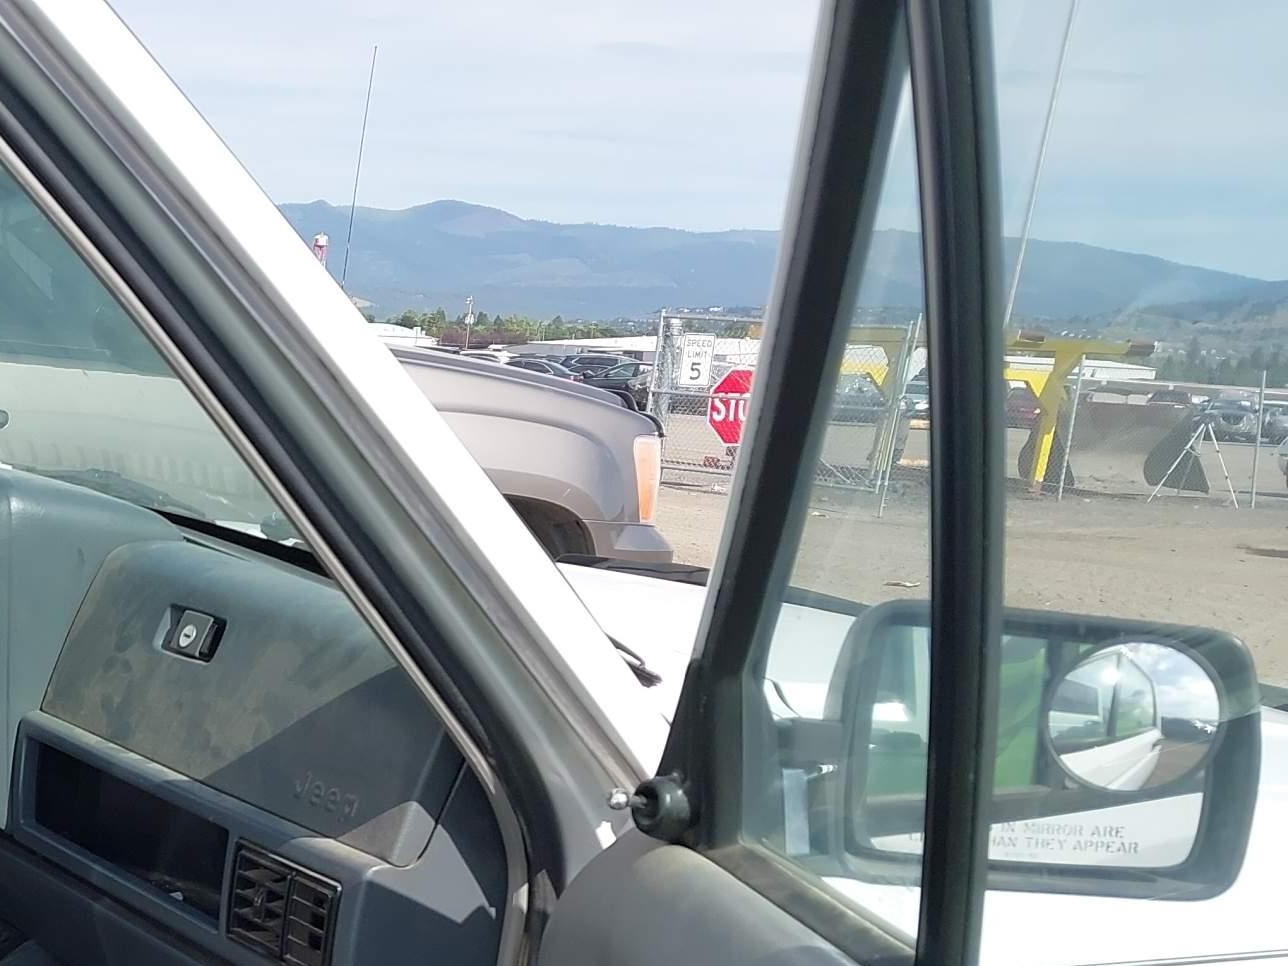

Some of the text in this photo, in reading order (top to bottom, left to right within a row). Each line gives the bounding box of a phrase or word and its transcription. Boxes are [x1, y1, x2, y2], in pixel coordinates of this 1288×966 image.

[686, 339, 712, 348] SPEED
[687, 351, 708, 359] LIMIT
[690, 362, 702, 380] 5
[711, 392, 749, 422] STO
[294, 770, 360, 823] Jeep
[1023, 822, 1083, 837] MIRROR
[1091, 825, 1125, 838] ARE
[1024, 836, 1066, 850] THEY
[1072, 839, 1139, 854] APPEAR
